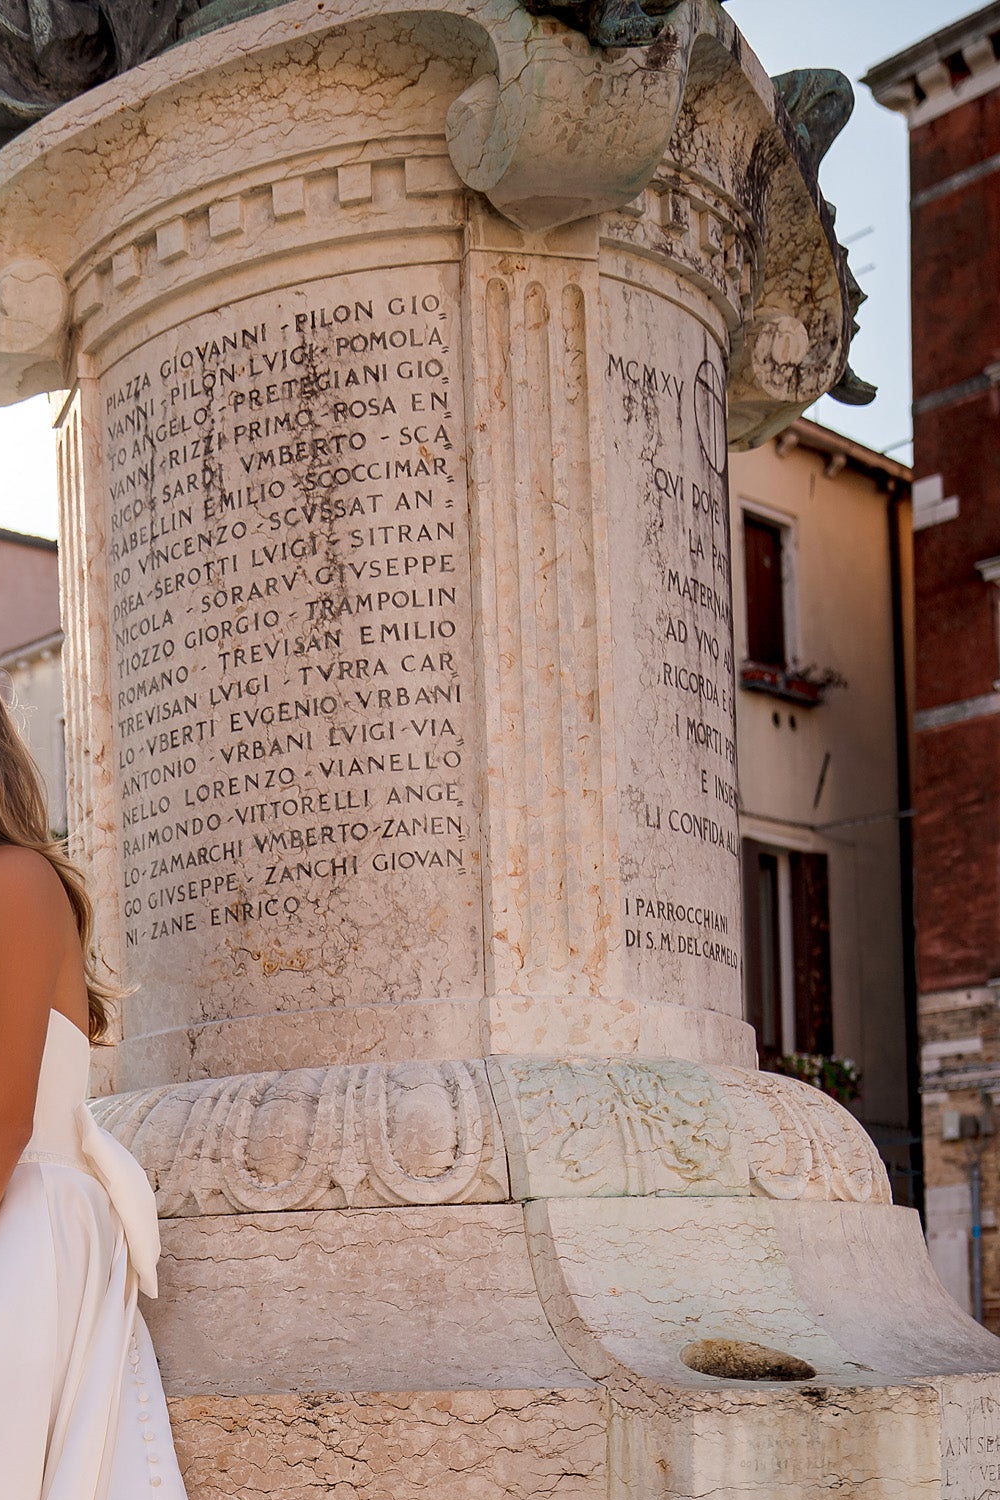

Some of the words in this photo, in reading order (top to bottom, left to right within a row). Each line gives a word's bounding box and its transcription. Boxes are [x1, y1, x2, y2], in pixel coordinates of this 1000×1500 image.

[107, 372, 151, 415] PIAZZA
[160, 323, 267, 378] GIOVANNI
[295, 300, 373, 332] PILON
[608, 354, 684, 402] MCMXV
[107, 399, 154, 441] VANNI
[171, 364, 235, 406] PILON
[109, 459, 155, 500] VANNI
[169, 432, 223, 469] RIZZI
[234, 409, 313, 444] PRIMO
[333, 396, 397, 422] ROSA
[111, 499, 143, 533] RICO
[162, 464, 224, 504] SARDI
[240, 432, 367, 474] VMBERTO
[655, 468, 684, 500] QVI
[692, 483, 720, 525] DOVE
[111, 506, 192, 563] RABELLIN
[204, 481, 285, 520] EMILIO
[114, 567, 130, 592] RO
[138, 522, 247, 575] VINCENZO
[269, 493, 383, 531] SCVSSAT
[689, 528, 705, 560] LA
[114, 592, 144, 622] DREA
[154, 554, 237, 600] SEROTTI
[252, 534, 318, 567] LVIGI
[351, 522, 454, 548] SITRAN
[115, 609, 174, 650] NICOLA
[316, 555, 456, 584] GIVSEPPE
[118, 639, 175, 679] TIOZZO
[185, 610, 279, 649] GIORGIO
[305, 587, 456, 621] TRAMPOLIN
[118, 666, 189, 710] ROMANO
[219, 630, 342, 671] TREVISAN
[360, 621, 456, 644] EMILIO
[666, 617, 688, 643] AD
[694, 625, 719, 660] VNO
[119, 693, 197, 739] TREVISAN
[210, 675, 269, 706] LVIGI
[300, 658, 388, 685] TVRRA
[230, 696, 337, 733] EVGENIO
[355, 685, 461, 709] VRBANI
[663, 662, 719, 707] RICORDA
[122, 757, 196, 800] ANTONIO
[220, 731, 312, 764] VRBANI
[687, 717, 722, 755] MORTI
[122, 796, 170, 828] NELLO
[185, 767, 295, 806] LORENZO
[319, 751, 461, 779] VIANELLO
[701, 769, 708, 793] E
[669, 810, 724, 848] CONFIDA
[124, 898, 141, 918] GO
[148, 873, 238, 910] GIVSEPPE
[265, 855, 358, 885] ZANCHI
[211, 897, 300, 926] ENRICO
[625, 898, 629, 915] I
[636, 898, 728, 934] PARROCCHIANI
[625, 929, 641, 948] DI
[678, 936, 701, 957] DEL
[702, 941, 737, 969] CARMELO
